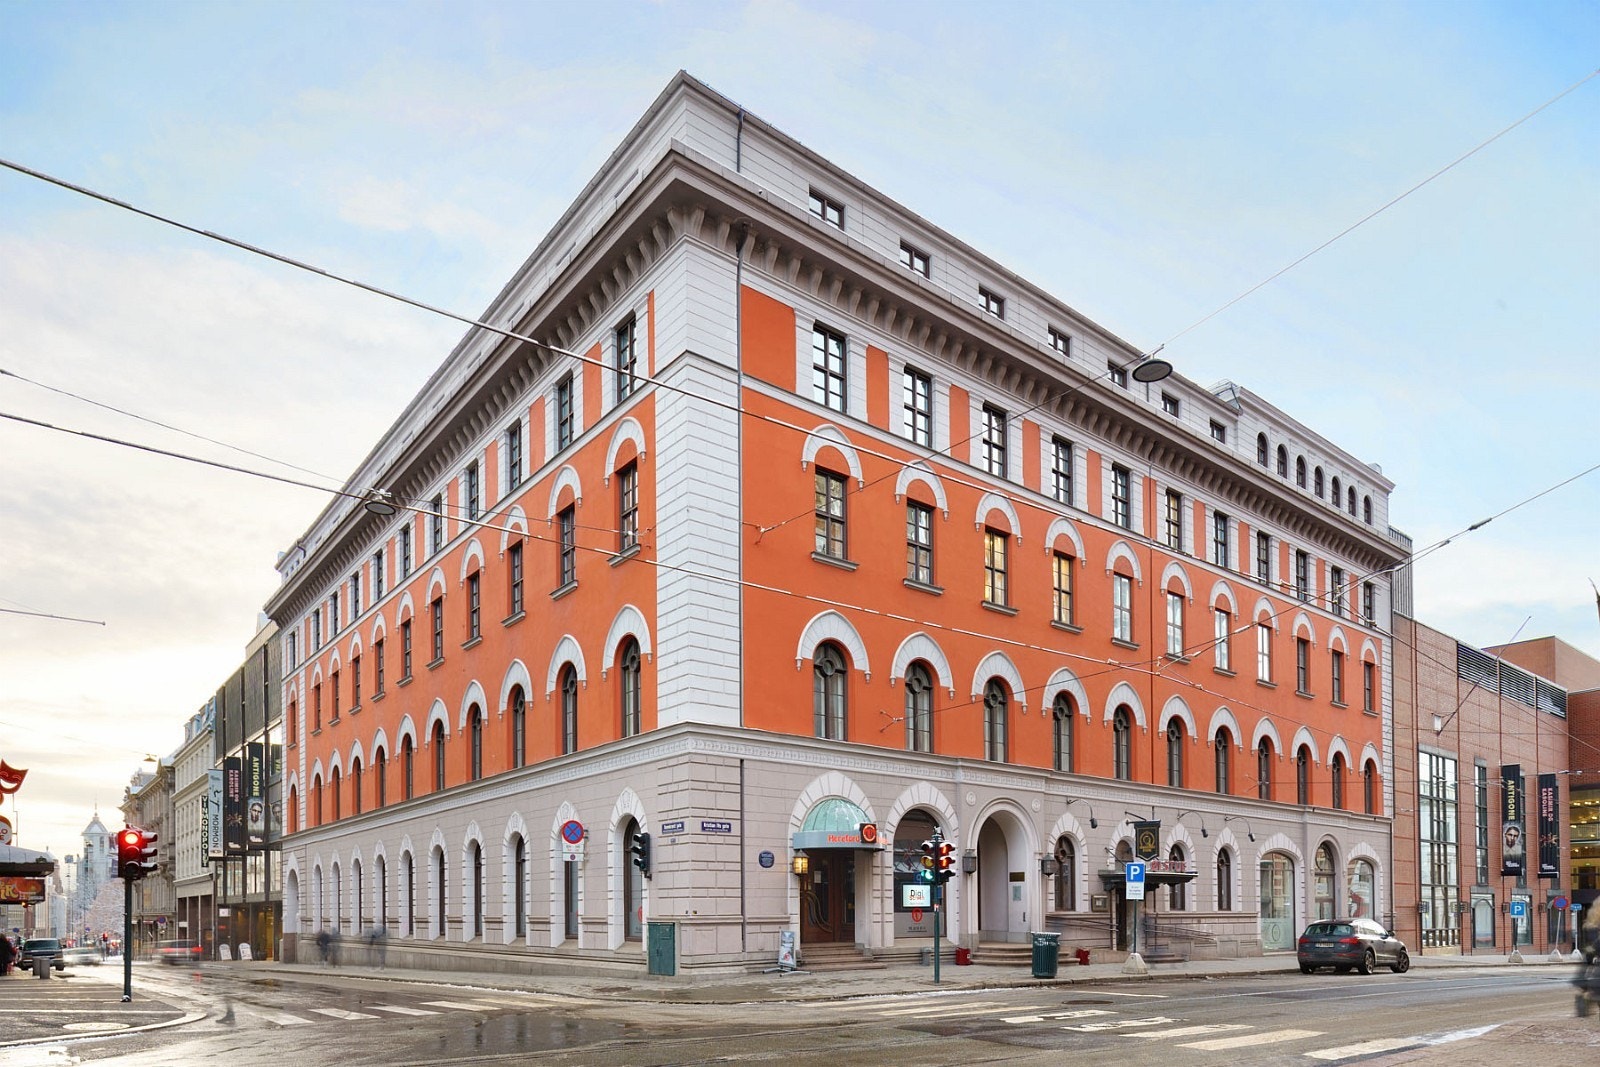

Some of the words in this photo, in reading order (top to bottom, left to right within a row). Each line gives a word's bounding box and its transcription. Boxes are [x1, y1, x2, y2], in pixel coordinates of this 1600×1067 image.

[252, 757, 260, 797] ANTIGONE
[1507, 780, 1515, 820] ANTIGONE
[1130, 866, 1140, 880] P
[1514, 906, 1521, 914] P
